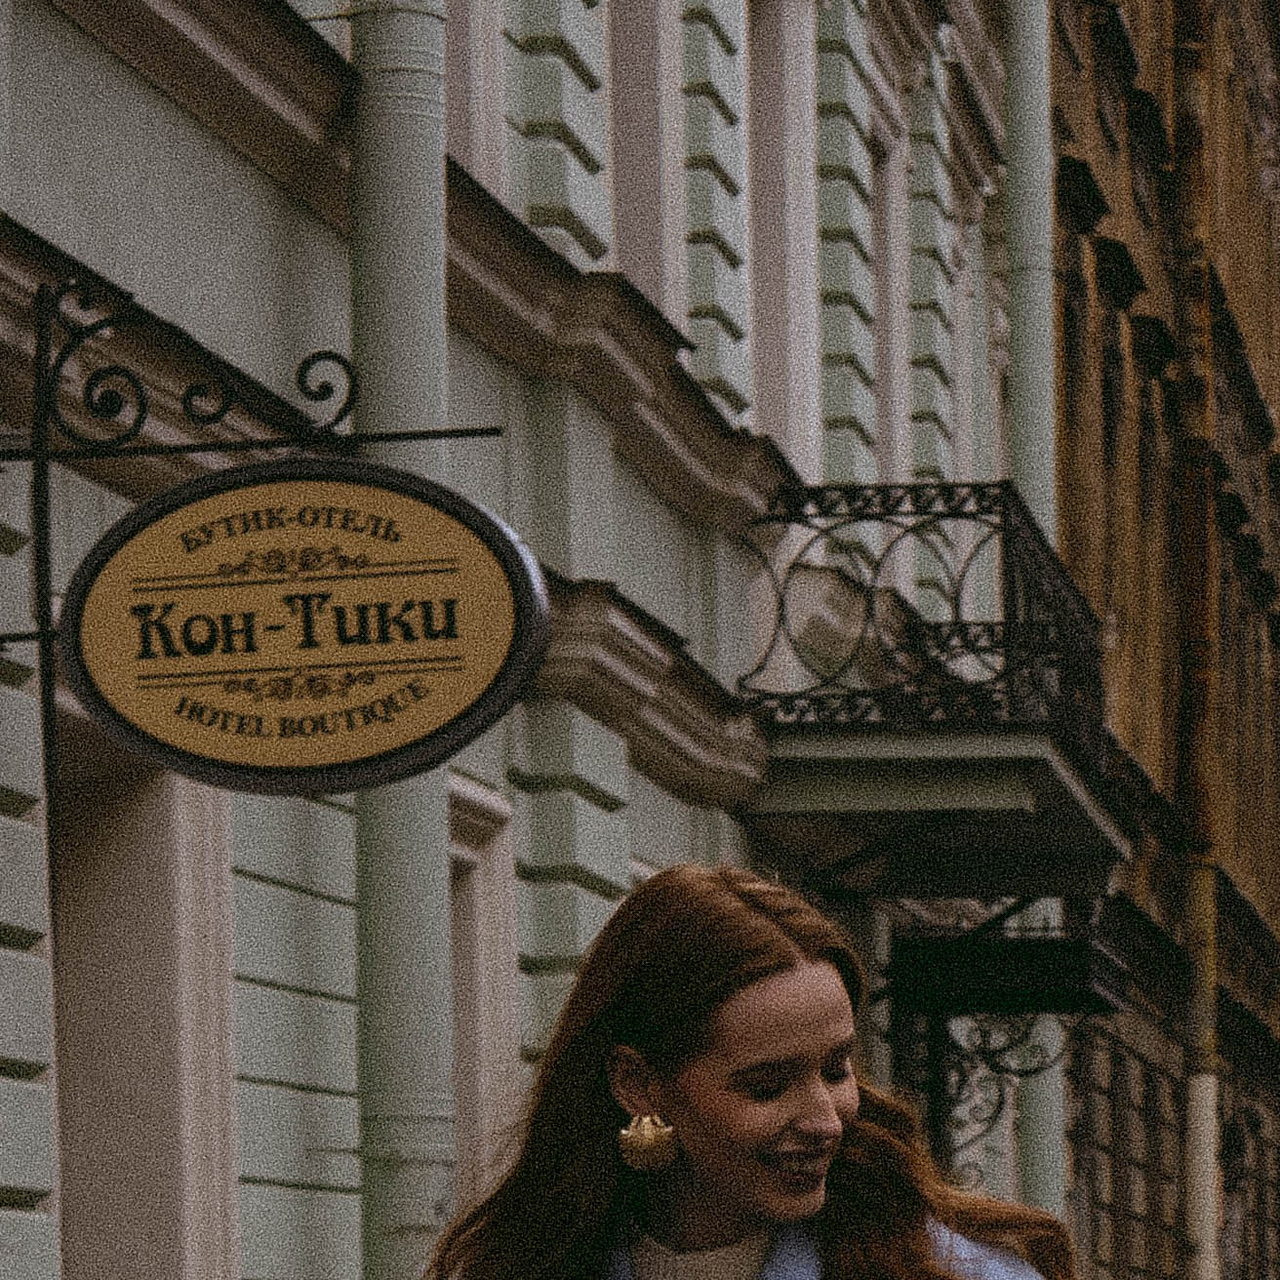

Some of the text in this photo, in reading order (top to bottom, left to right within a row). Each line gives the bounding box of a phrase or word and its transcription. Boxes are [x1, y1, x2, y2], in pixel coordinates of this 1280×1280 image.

[181, 505, 401, 552] БУТИК-ОТЕЛЬ
[131, 592, 459, 660] Кон-Тики
[174, 679, 429, 738] HOTEL BOUTIQUE
